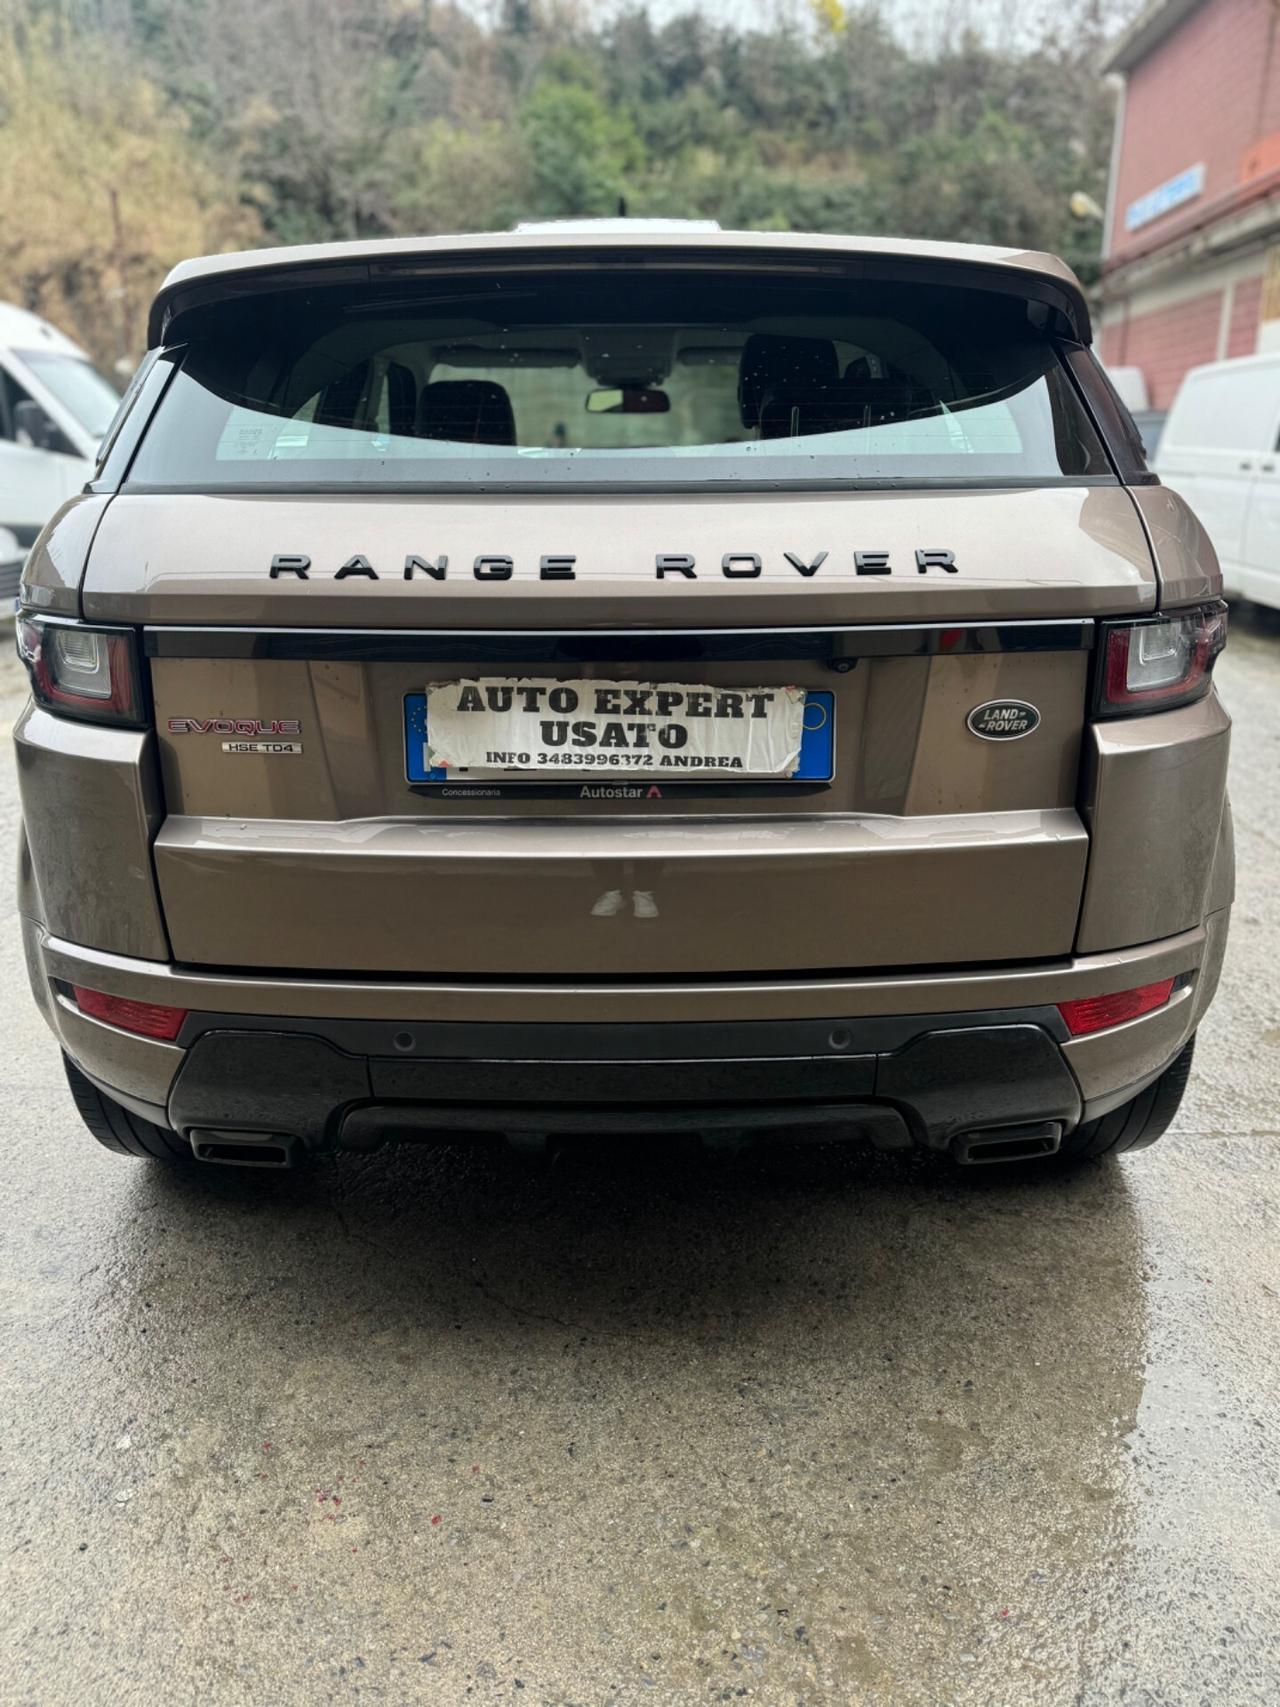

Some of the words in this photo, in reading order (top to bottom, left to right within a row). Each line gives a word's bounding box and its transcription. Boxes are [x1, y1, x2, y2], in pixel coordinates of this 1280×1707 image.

[269, 553, 576, 581] RANGE
[655, 548, 959, 579] ROVER
[457, 686, 579, 714] AUTO
[594, 689, 775, 718] EXPERT
[984, 708, 1018, 720] LAND
[167, 718, 300, 735] EVOQUE
[985, 720, 1028, 731] ROVER
[540, 720, 688, 749] USATO
[228, 743, 258, 752] HSE
[262, 744, 294, 752] TD4
[486, 751, 531, 764] INFO
[537, 752, 654, 766] 3483996372
[659, 755, 743, 769] ANDREA
[442, 788, 501, 796] Concessionaria
[580, 786, 643, 799] Autostar
